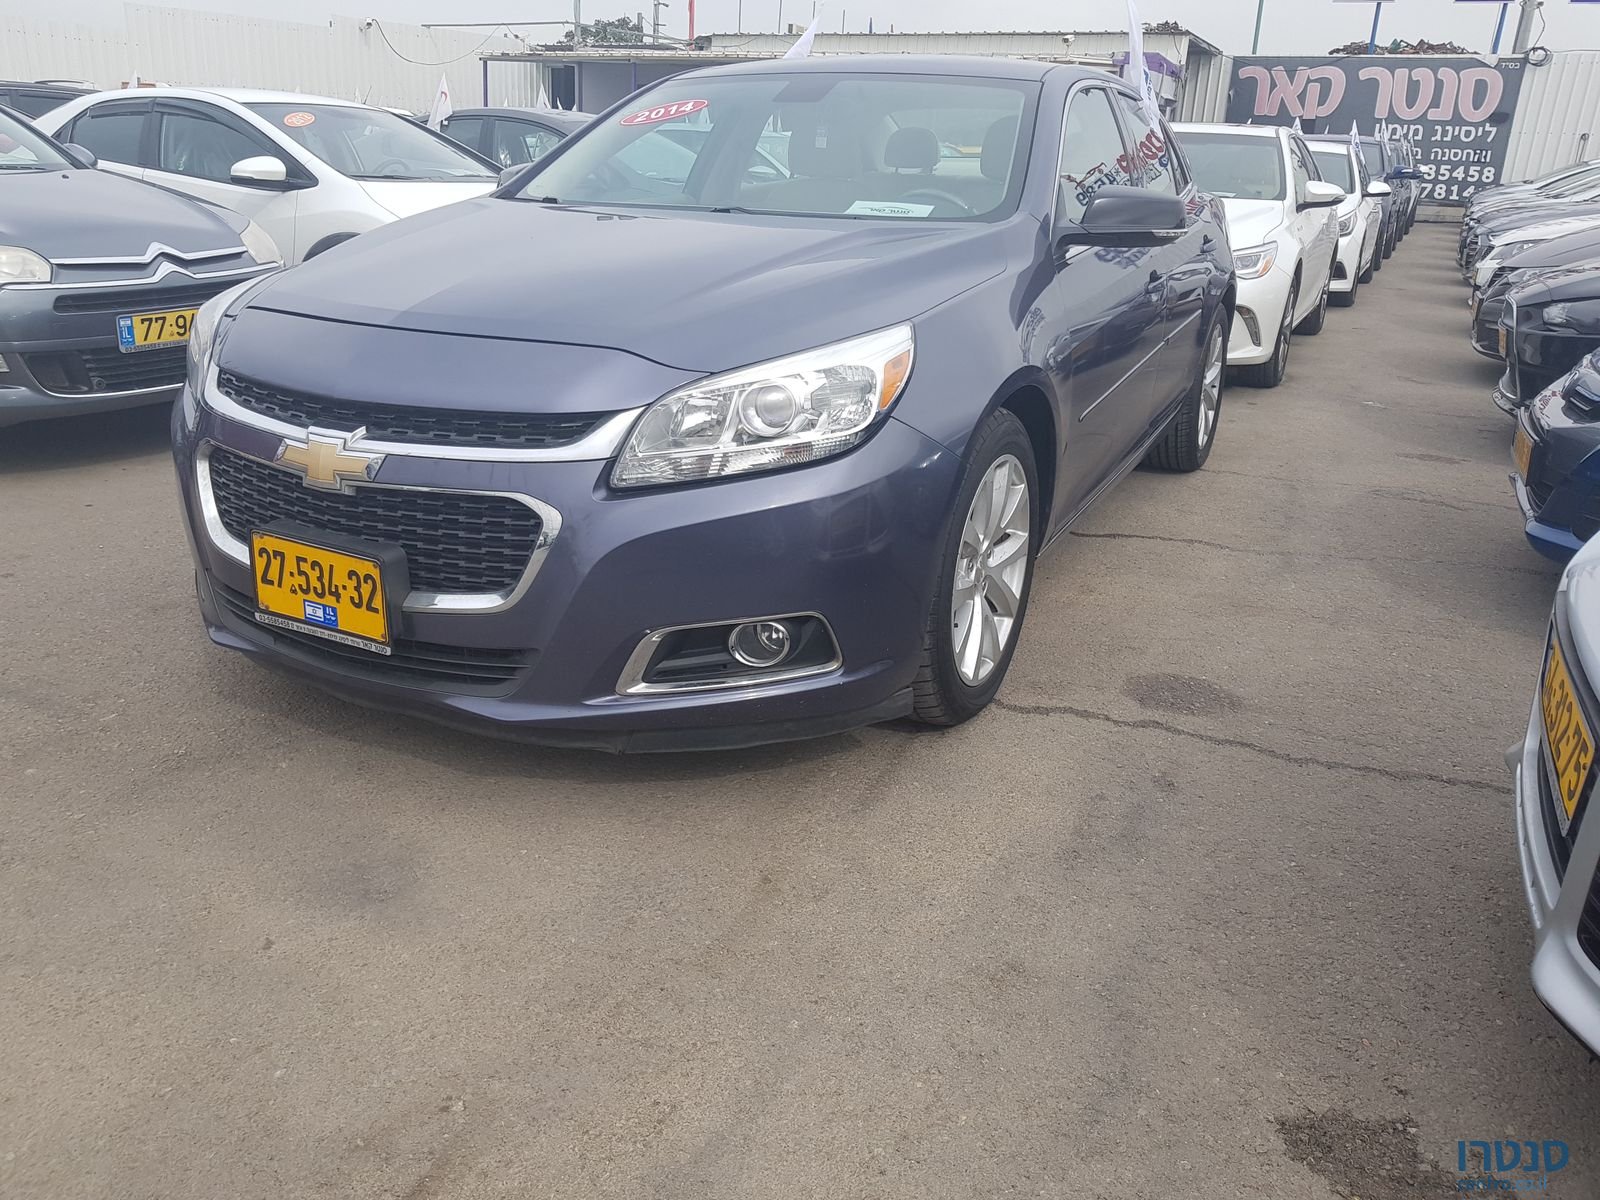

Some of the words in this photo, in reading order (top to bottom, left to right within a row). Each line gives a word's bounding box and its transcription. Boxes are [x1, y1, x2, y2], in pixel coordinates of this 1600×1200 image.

[1238, 65, 1347, 120] קאר
[1359, 67, 1504, 123] סנטר
[633, 102, 695, 123] 2014
[1431, 123, 1498, 143] ליסינג
